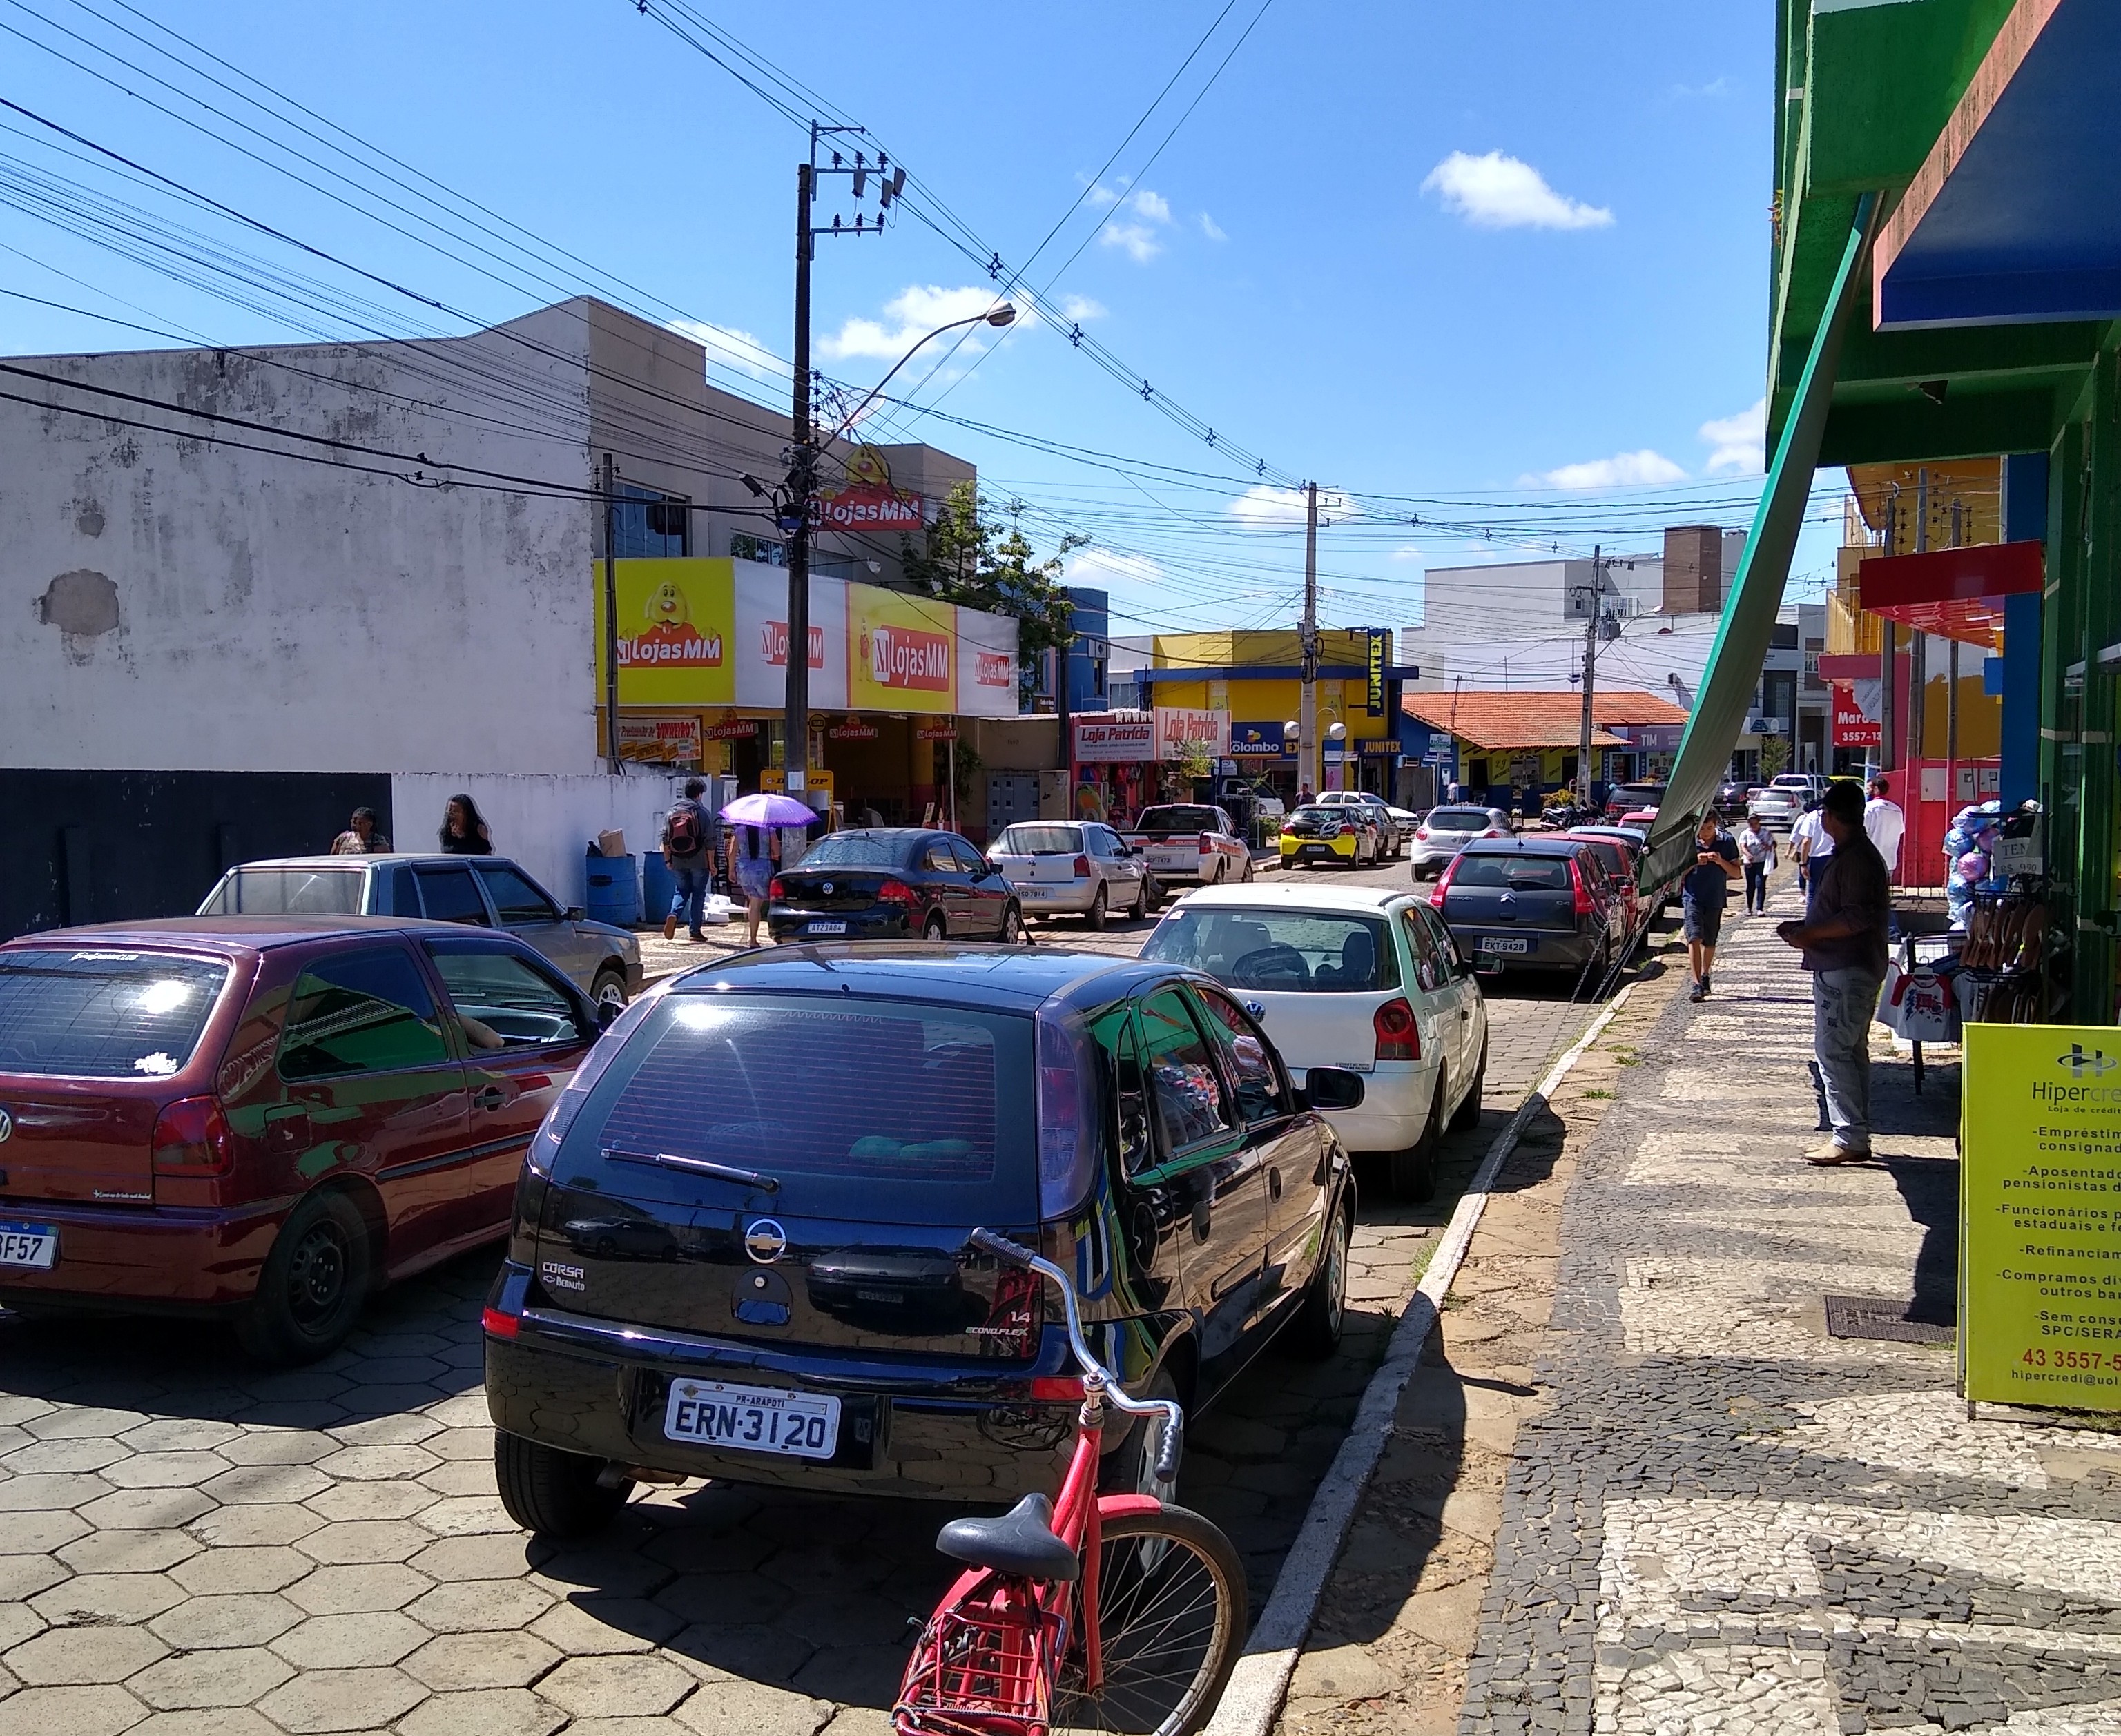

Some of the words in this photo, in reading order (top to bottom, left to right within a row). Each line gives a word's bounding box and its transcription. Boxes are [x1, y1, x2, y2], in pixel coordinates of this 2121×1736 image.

[1370, 634, 1382, 710] JUNITEX
[1163, 710, 1184, 741] Loja
[1081, 728, 1106, 743] Loja
[1108, 727, 1150, 741] Patrícia
[1640, 734, 1657, 746] TIM
[1364, 741, 1401, 753] JUNITEX
[2032, 1081, 2121, 1106] Hipercre
[2003, 1179, 2107, 1191] pensionistas
[1995, 1204, 2108, 1218] -Funcionários
[2014, 1218, 2092, 1231] estaduais
[2098, 1223, 2105, 1231] e
[542, 1261, 585, 1280] CORSA
[1996, 1269, 2097, 1284] -Compramos
[2102, 1275, 2121, 1285] di
[2040, 1287, 2092, 1298] outros
[2022, 1347, 2046, 1367] 43
[2053, 1349, 2121, 1372] 3557-5
